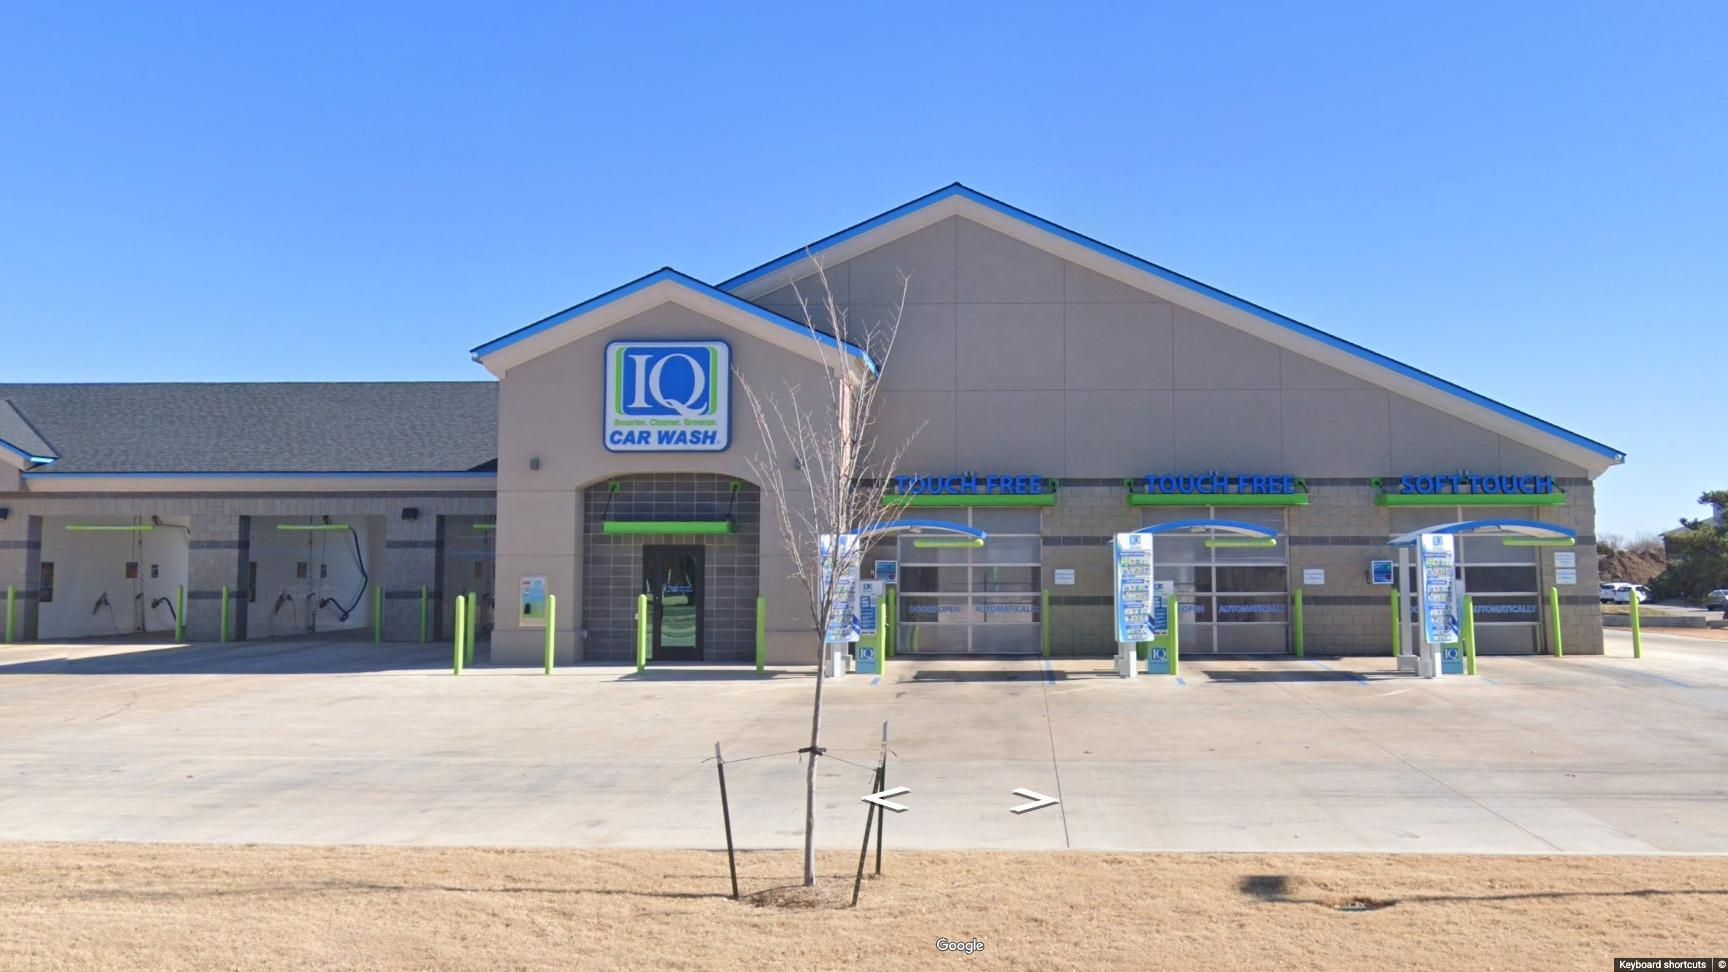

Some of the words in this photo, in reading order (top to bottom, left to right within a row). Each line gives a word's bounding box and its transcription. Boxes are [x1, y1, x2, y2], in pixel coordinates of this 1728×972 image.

[627, 353, 708, 416] IQ
[610, 430, 651, 445] CAR
[657, 430, 718, 445] WASH
[895, 474, 977, 495] TOUCH
[986, 474, 1042, 495] FREE
[1145, 473, 1228, 494] TOUCH
[1237, 473, 1297, 494] FREE
[1400, 473, 1459, 494] SOFT
[1465, 473, 1553, 494] TOUCH
[860, 648, 874, 660] IQ
[1152, 648, 1167, 660] IQ
[1444, 647, 1458, 660] IQ
